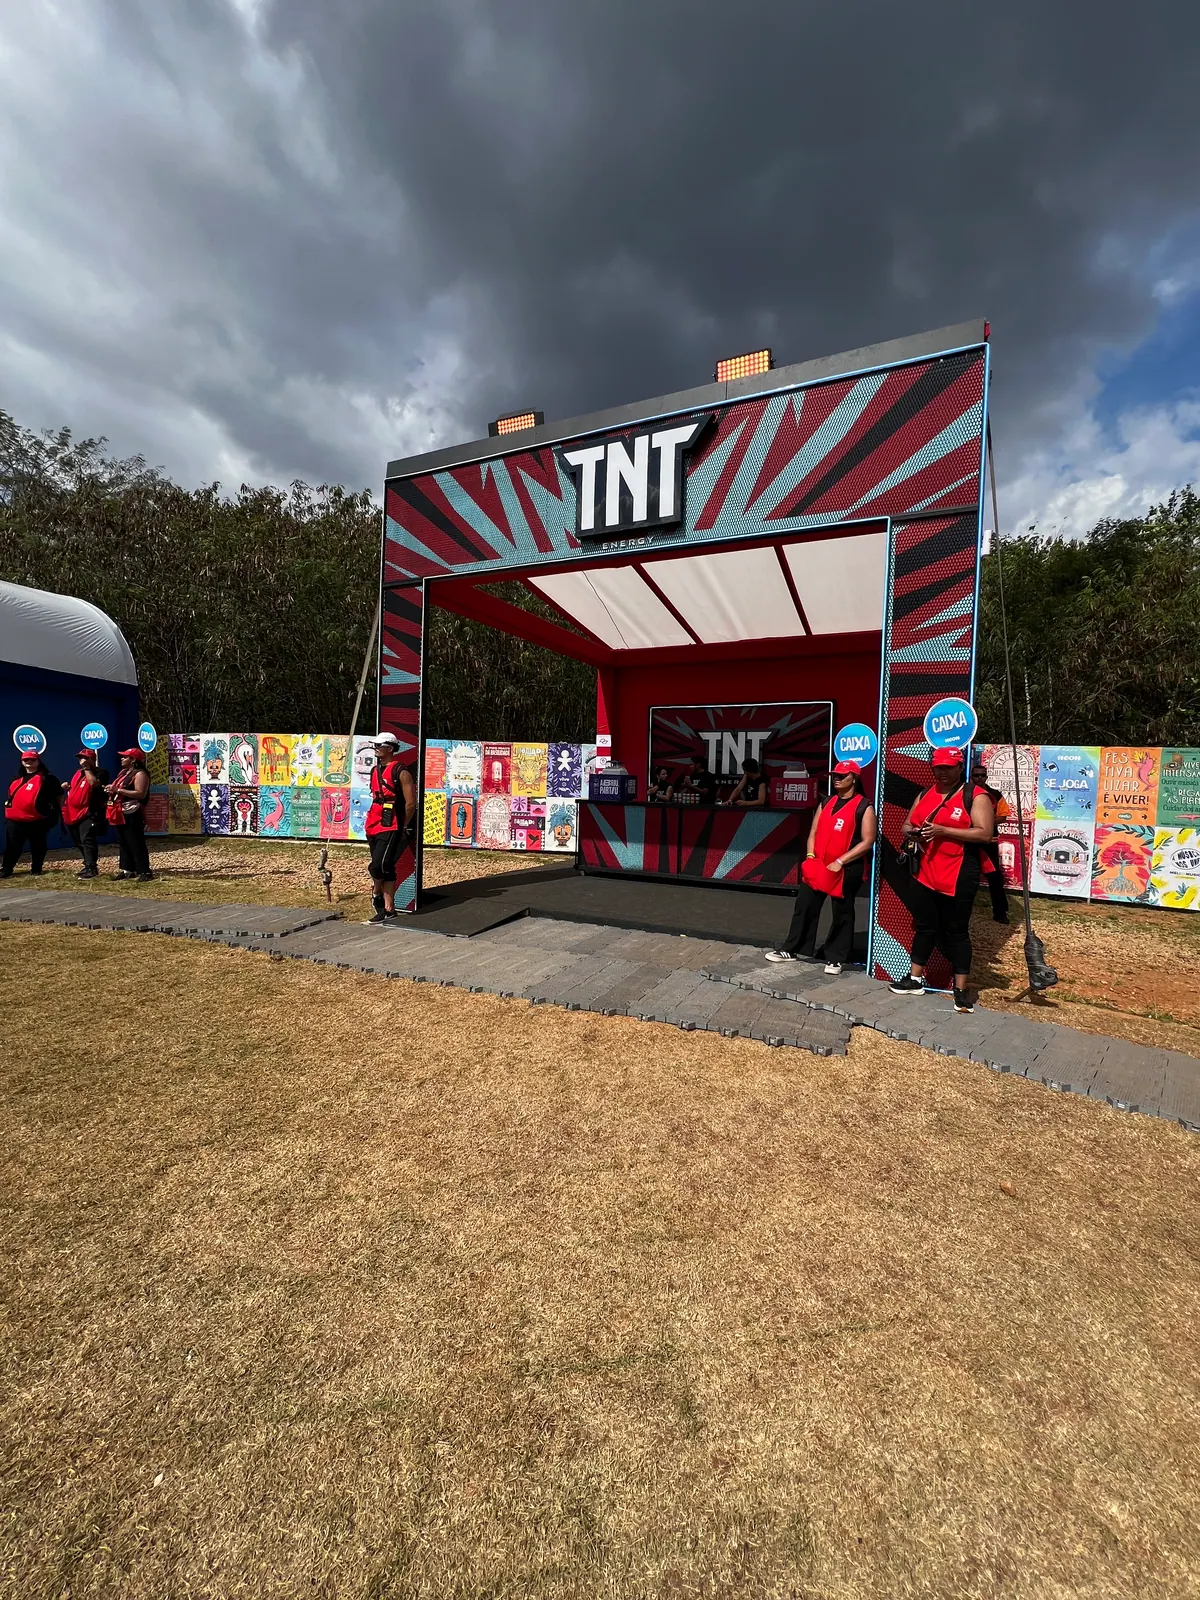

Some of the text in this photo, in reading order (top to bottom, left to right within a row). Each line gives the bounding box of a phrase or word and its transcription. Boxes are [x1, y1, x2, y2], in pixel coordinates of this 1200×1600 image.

[563, 423, 699, 531] TNT
[602, 535, 655, 550] ENERGY
[932, 711, 967, 733] CAIXA
[18, 734, 40, 744] CAIXA
[84, 730, 104, 739] CAIXA
[840, 735, 871, 751] CAIXA
[698, 731, 772, 774] TNT
[1105, 752, 1128, 764] FES
[1105, 766, 1133, 777] TIVA
[1184, 762, 1200, 770] VIVE
[1163, 769, 1200, 778] INTENSA
[1044, 778, 1088, 789] SE JOGA
[1104, 780, 1139, 791] LIZAR
[1178, 788, 1200, 797] REGA
[1104, 792, 1149, 805] É VIVER!
[1182, 797, 1200, 805] PLAN
